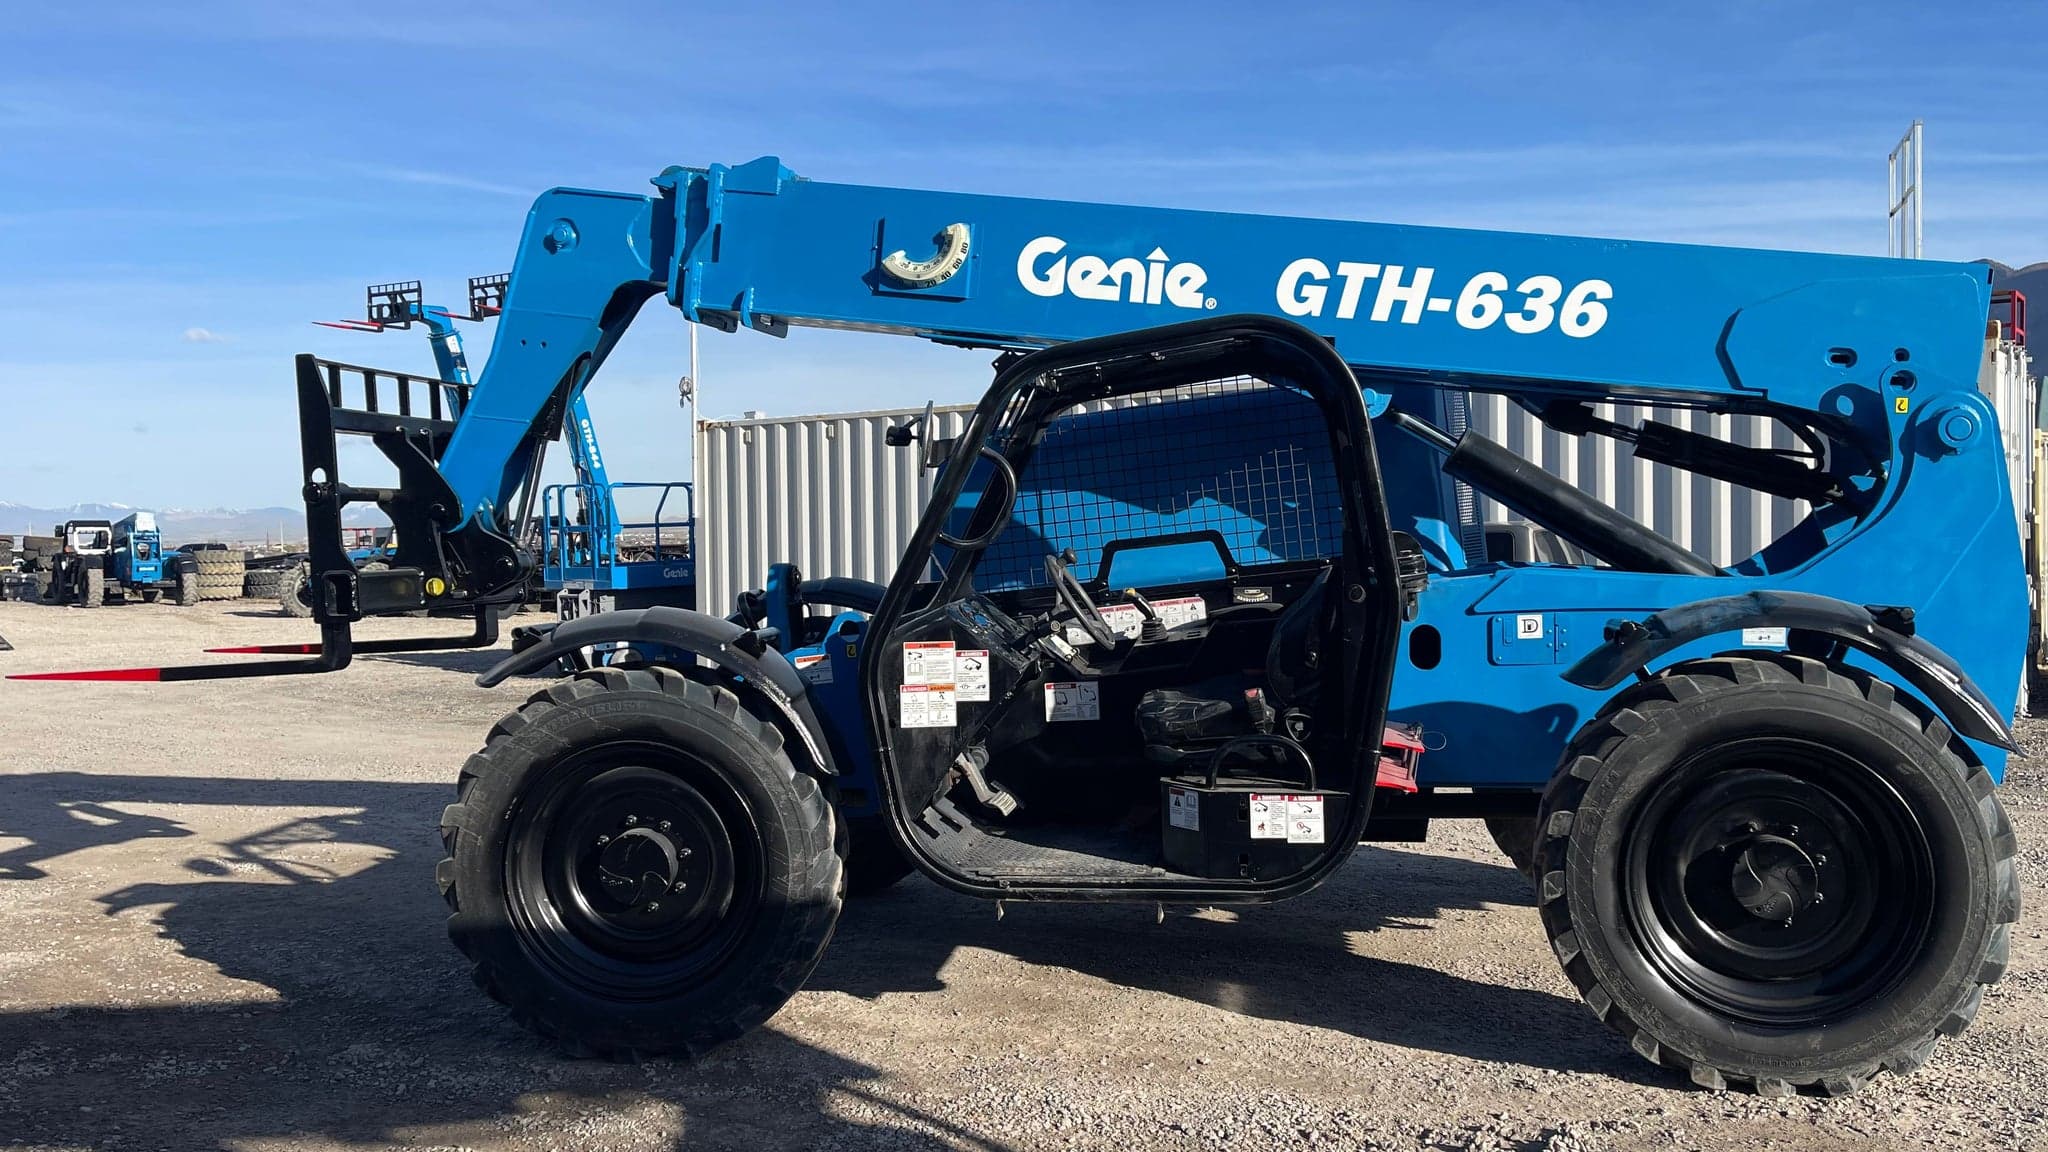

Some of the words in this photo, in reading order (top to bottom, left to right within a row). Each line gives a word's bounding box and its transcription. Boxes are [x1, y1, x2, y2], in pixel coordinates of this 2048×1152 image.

[925, 279, 937, 288] 20
[941, 270, 952, 280] 40
[952, 258, 962, 269] 60
[960, 242, 968, 254] 80
[1017, 236, 1208, 309] Genie
[1276, 258, 1613, 338] GTH-636
[663, 568, 689, 579] Genie
